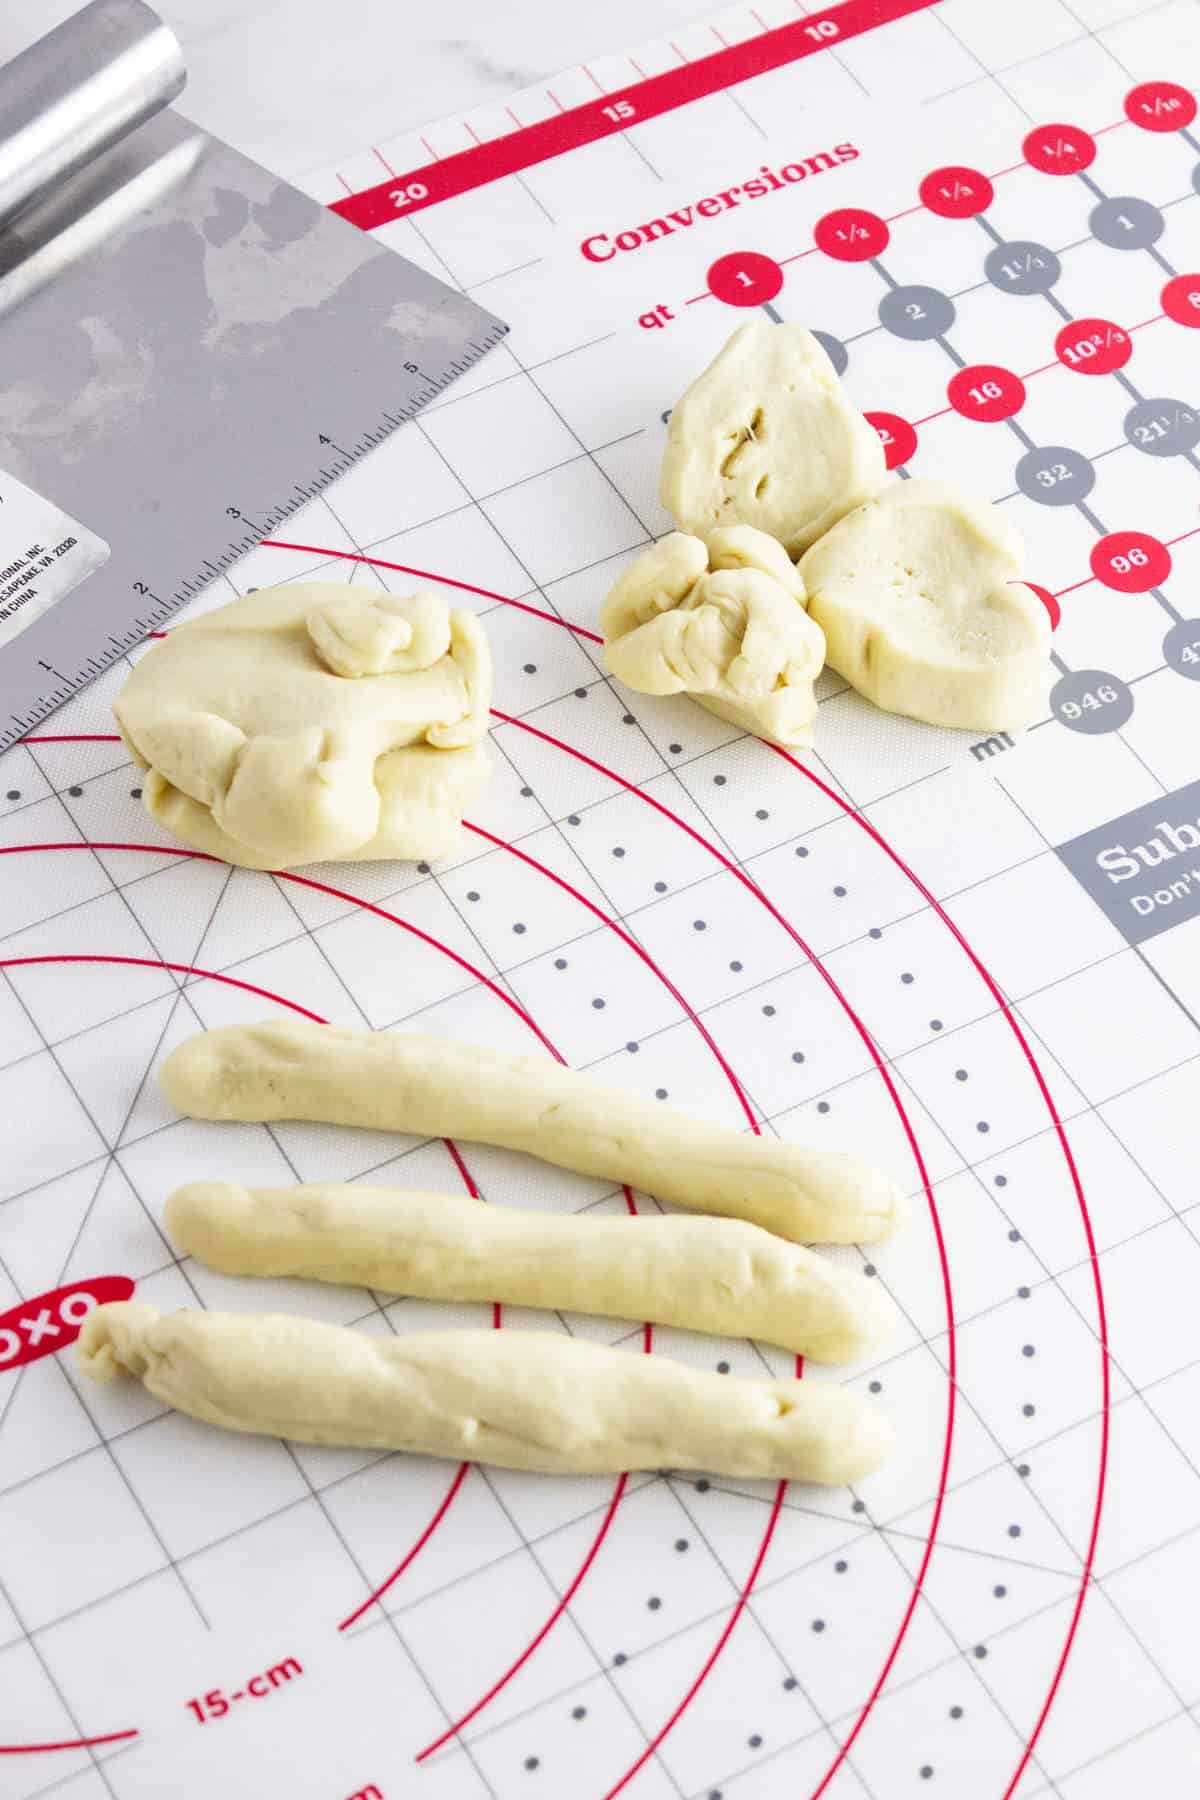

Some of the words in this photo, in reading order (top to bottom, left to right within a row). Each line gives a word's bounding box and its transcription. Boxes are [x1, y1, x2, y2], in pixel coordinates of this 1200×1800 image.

[804, 19, 840, 42] 10
[602, 100, 635, 122] 15
[388, 183, 429, 208] 20
[580, 141, 860, 263] Conversions
[905, 303, 926, 320] 2
[1117, 213, 1137, 231] 1
[638, 303, 675, 329] qt
[735, 271, 756, 288] 1
[403, 361, 419, 374] 5
[968, 381, 1003, 406] 16
[318, 433, 333, 447] 4
[1035, 462, 1073, 488] 32
[226, 506, 242, 520] 3
[38, 555, 55, 567] VA
[1109, 547, 1149, 574] 96
[8, 589, 38, 611] CHINA
[133, 581, 149, 595] 2
[38, 660, 51, 670] 1
[1060, 684, 1119, 720] 946
[186, 1657, 304, 1724] 15-cm
